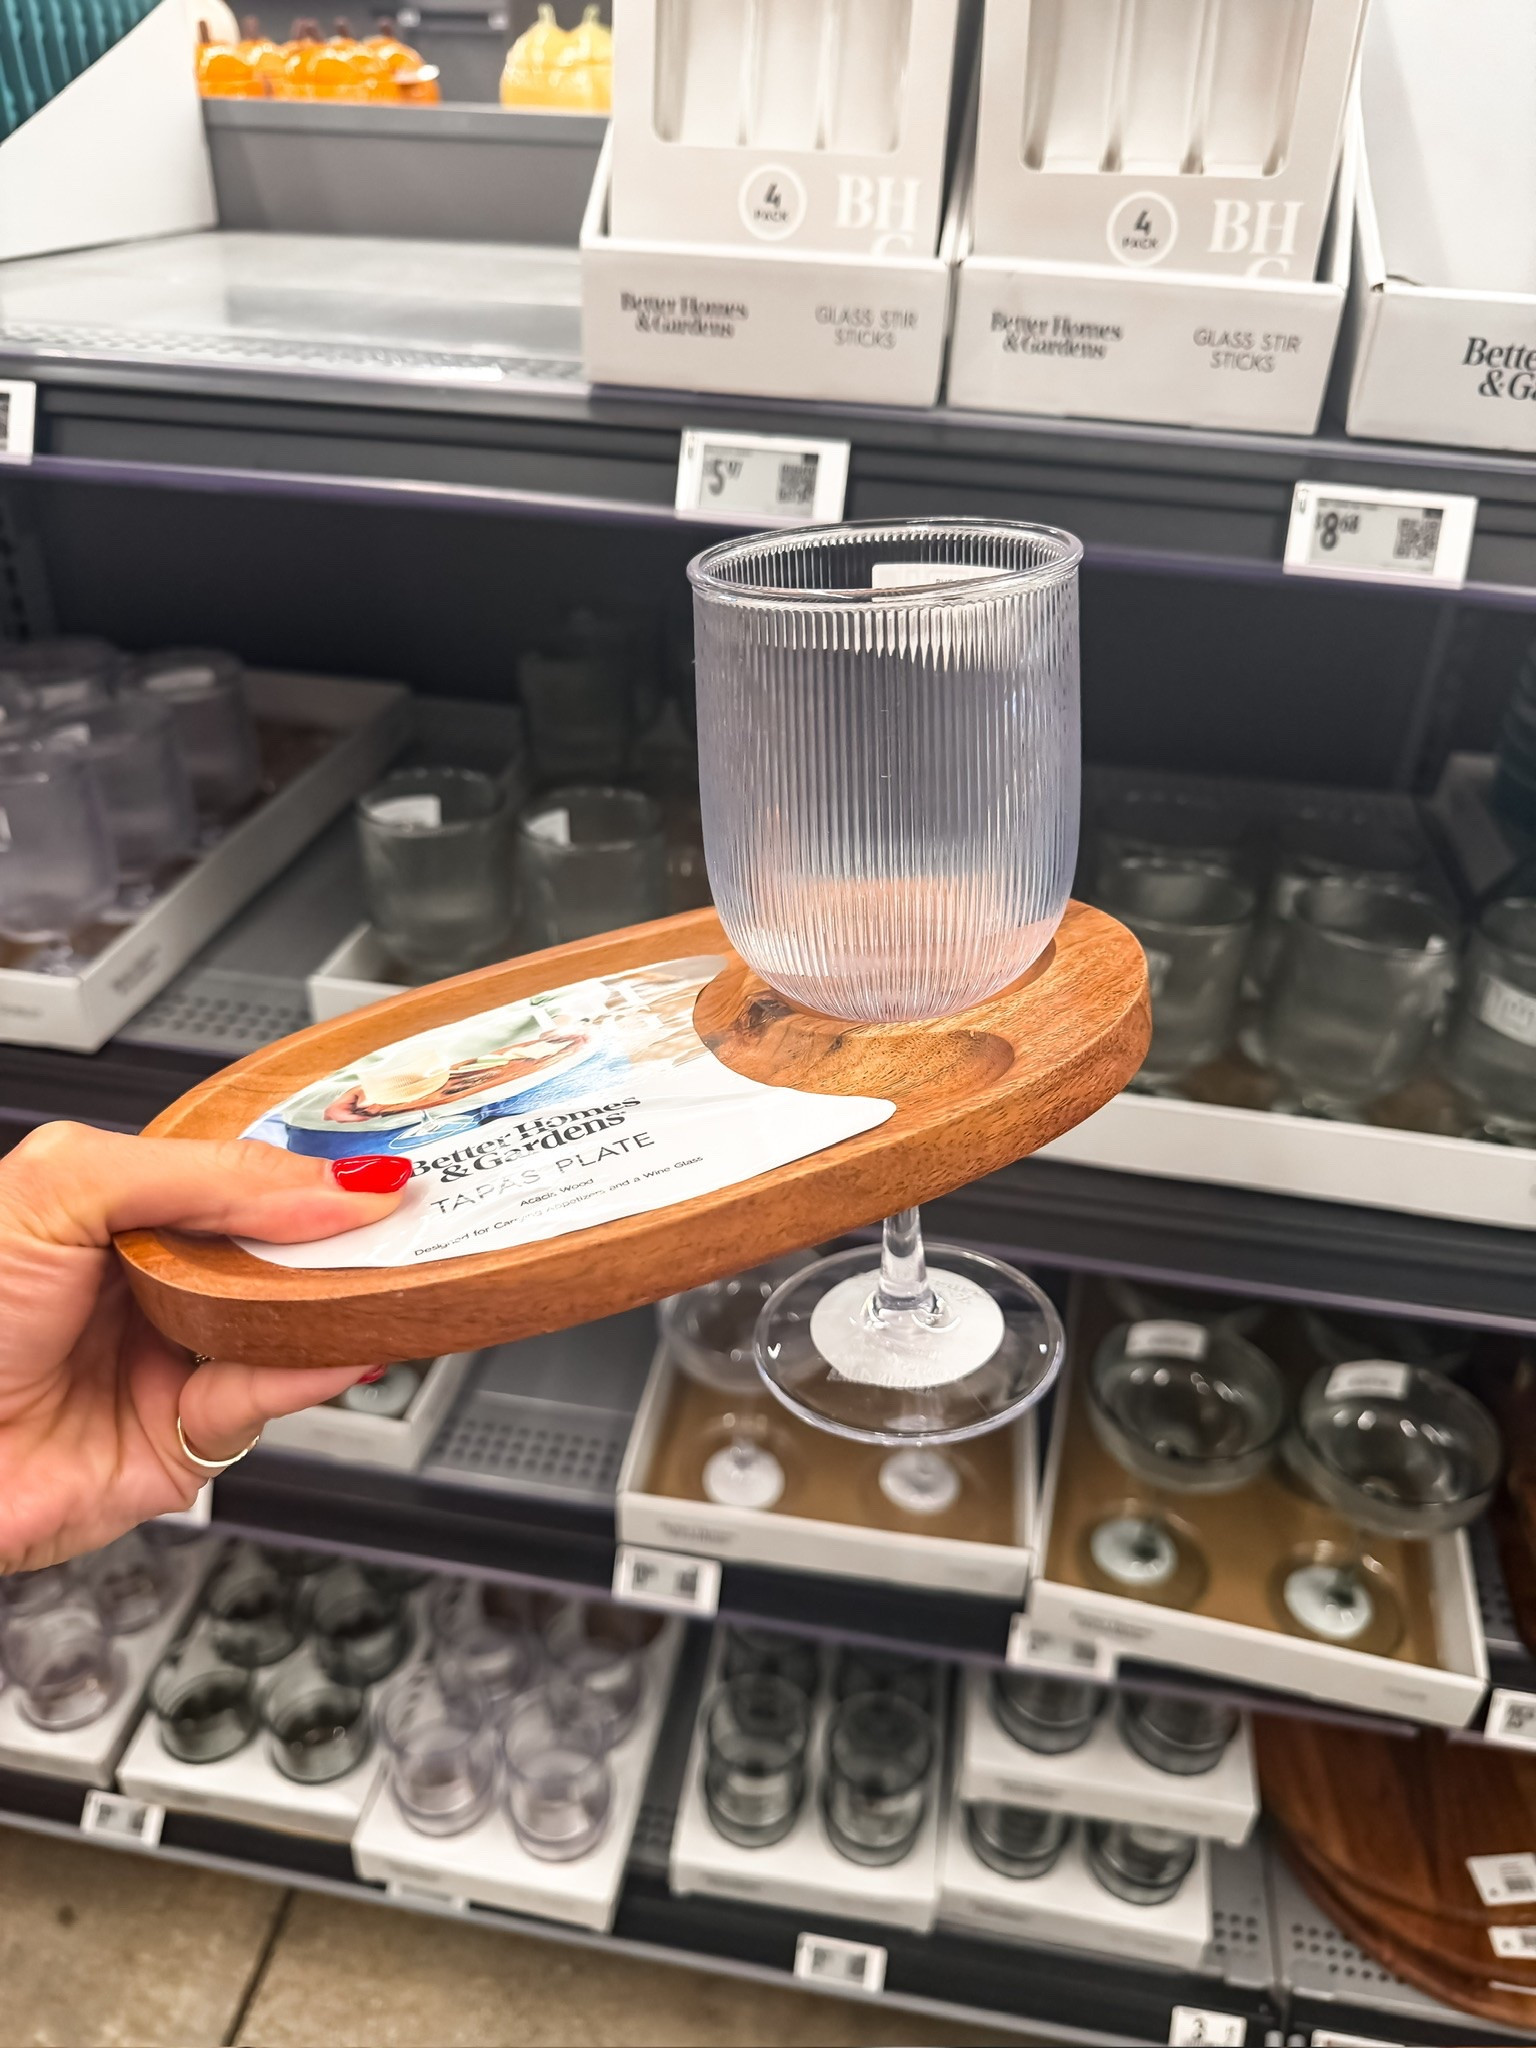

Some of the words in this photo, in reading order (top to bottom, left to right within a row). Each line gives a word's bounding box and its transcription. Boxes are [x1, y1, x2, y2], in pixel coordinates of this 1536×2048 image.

[764, 182, 781, 209] 4
[1134, 209, 1151, 234] 4
[1122, 236, 1159, 250] PACK
[815, 305, 874, 328] GLASS
[880, 310, 918, 330] STIR
[1053, 316, 1124, 342] Homes
[834, 329, 896, 349] STICKS
[1193, 328, 1255, 351] GLASS
[1262, 333, 1302, 353] STIR
[1210, 351, 1275, 373] STICKS
[410, 1131, 511, 1177] Better
[513, 1096, 641, 1140] Homes
[430, 1169, 541, 1214] TAPAS
[555, 1131, 655, 1174] PLATE
[559, 1178, 594, 1193] Wood
[414, 1233, 470, 1256] Designed
[473, 1226, 490, 1237] for
[609, 1179, 630, 1191] and
[642, 1166, 671, 1179] Wine
[673, 1155, 704, 1169] Glass
